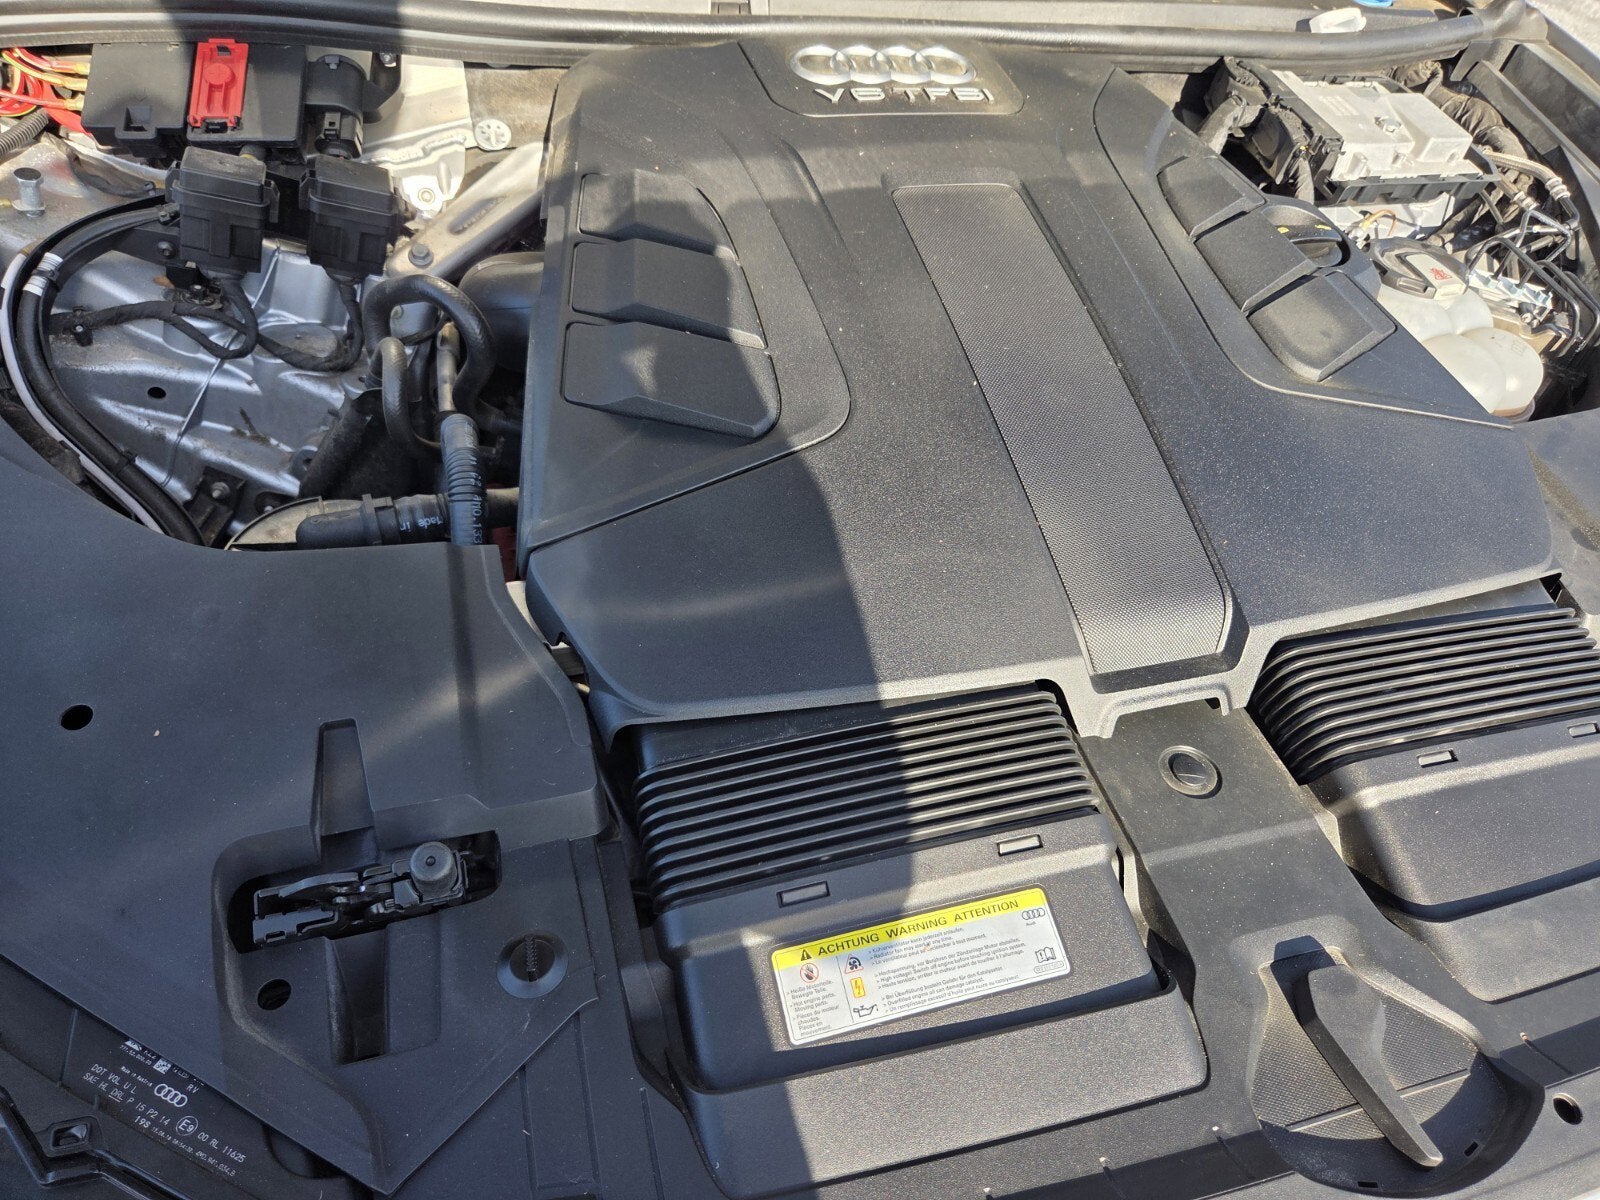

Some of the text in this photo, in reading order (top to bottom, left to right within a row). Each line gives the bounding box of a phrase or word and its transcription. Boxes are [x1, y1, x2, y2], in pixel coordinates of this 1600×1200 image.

[891, 87, 995, 105] TFSI
[818, 899, 1018, 955] ACHTUNG WARNING ATTENTION
[92, 1063, 106, 1075] DOT
[83, 1072, 98, 1084] SAE
[99, 1081, 109, 1091] HL
[110, 1088, 125, 1100] DRL
[134, 1115, 150, 1128] 19S
[223, 1146, 245, 1163] 11625
